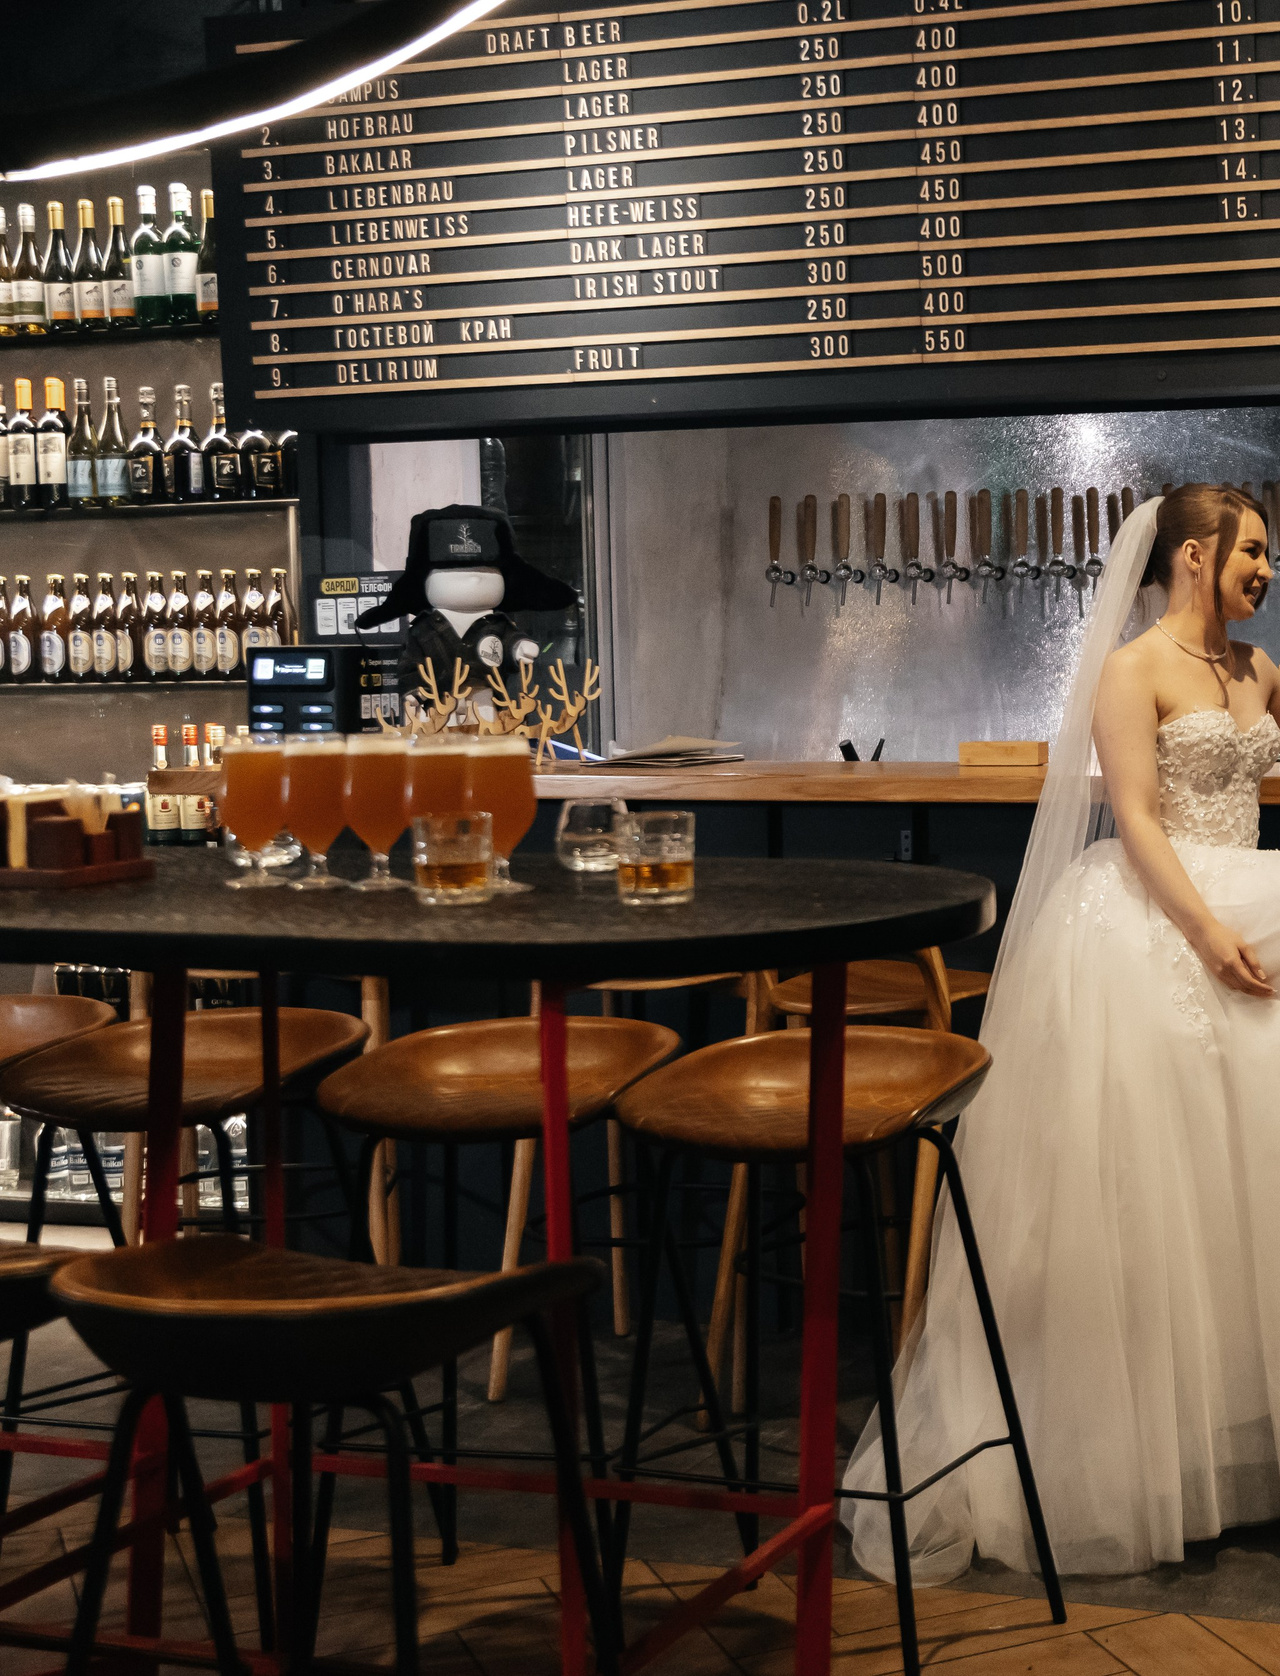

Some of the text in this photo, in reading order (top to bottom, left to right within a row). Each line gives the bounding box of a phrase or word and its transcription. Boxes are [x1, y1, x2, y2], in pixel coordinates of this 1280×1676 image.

[798, 0, 845, 24] 0.2L
[1217, 1, 1251, 23] 10.
[487, 22, 620, 53] DRAFT BEER
[916, 27, 955, 50] 400
[800, 38, 838, 61] 250
[1217, 40, 1251, 63] 11.
[565, 58, 627, 82] LAGER
[917, 65, 955, 88] 400
[802, 75, 840, 98] 250
[1218, 79, 1253, 102] 12.
[566, 93, 629, 119] LAGER
[918, 103, 957, 126] 400
[262, 113, 413, 146] 2. HOFBRAU
[803, 112, 841, 135] 250
[1221, 118, 1255, 141] 13.
[565, 128, 658, 155] PILSNER
[921, 141, 960, 164] 450
[264, 149, 411, 180] 3. BAKALAR
[804, 149, 842, 172] 250
[1222, 158, 1256, 180] 14.
[568, 166, 632, 191] LAGER
[920, 179, 959, 201] 450
[265, 181, 453, 214] 4. LIEBENBRAU
[806, 187, 844, 209] 250
[1222, 197, 1257, 219] 15.
[568, 198, 697, 227] HEFE-WEISS
[267, 214, 468, 249] 5. LIEBENWEISS
[805, 223, 844, 247] 250
[920, 216, 960, 238] 400
[571, 234, 706, 263] DARK LAGER
[268, 253, 430, 283] 6. CERNOVAR
[808, 261, 845, 283] 300
[923, 254, 962, 276] 500
[575, 269, 719, 298] IRISH STOUT
[271, 299, 288, 318] 7.
[807, 298, 845, 320] 250
[924, 292, 963, 313] 400
[271, 318, 511, 352] 8. ГОСТЕВОЙ КРАН
[811, 335, 848, 357] 300
[926, 329, 964, 351] 550
[575, 347, 639, 370] FRUIT
[272, 359, 437, 387] 9. DELIRIUM
[325, 580, 393, 593] ЗАРЯДИ ТЕЛЕФОН
